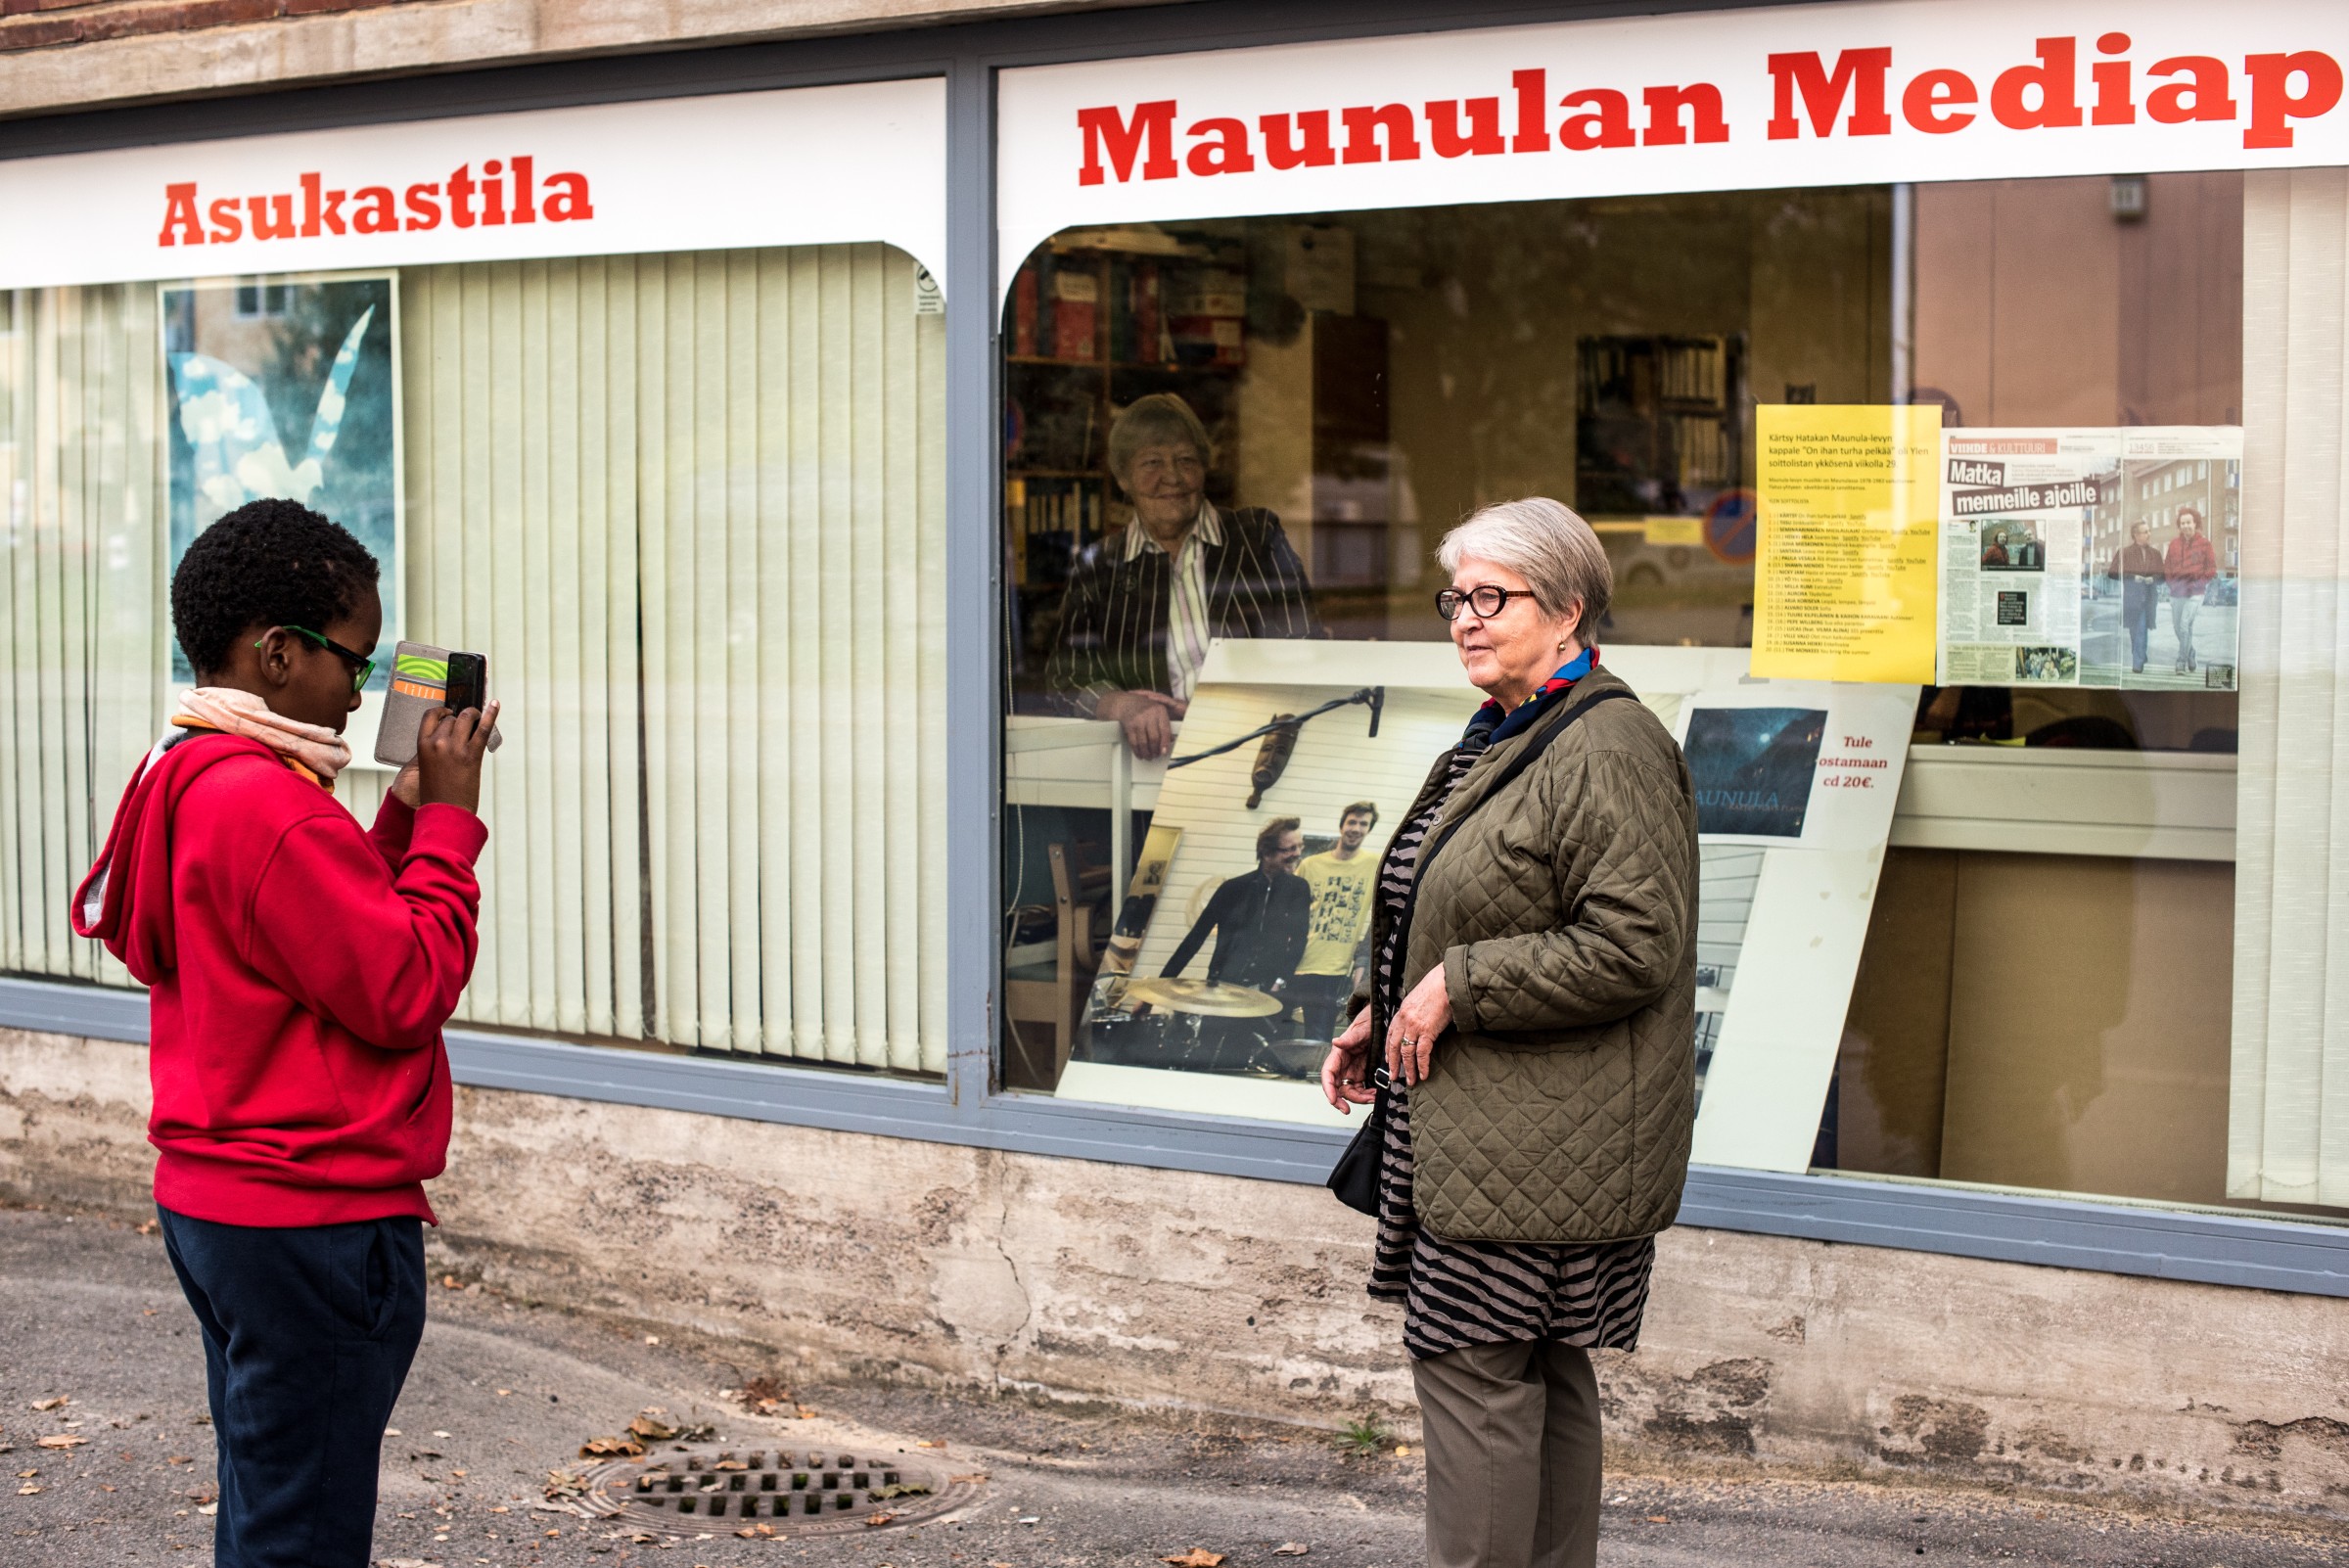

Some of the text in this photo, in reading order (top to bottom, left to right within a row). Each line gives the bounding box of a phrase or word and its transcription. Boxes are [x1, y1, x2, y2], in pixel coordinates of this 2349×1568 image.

[1078, 31, 2344, 187] Maunulan Mediap
[158, 154, 594, 248] Asukastila
[1769, 435, 1793, 443] Kärtsy
[1831, 435, 1893, 444] Maunula-levyn
[1769, 446, 1801, 456] kappale
[1950, 442, 1988, 454] VIIHDE
[1989, 442, 1997, 453] &
[1997, 442, 2046, 454] KULTTUURI
[1816, 460, 1853, 470] ykkösenä
[1856, 460, 1884, 469] viikolla
[1950, 461, 2002, 485] Matka
[1957, 483, 2096, 513] menneille ajoille
[1844, 736, 1873, 749] Tule
[1819, 756, 1888, 769] ostamaan
[1823, 775, 1839, 788] cd
[1695, 790, 1779, 807] AUNULA
